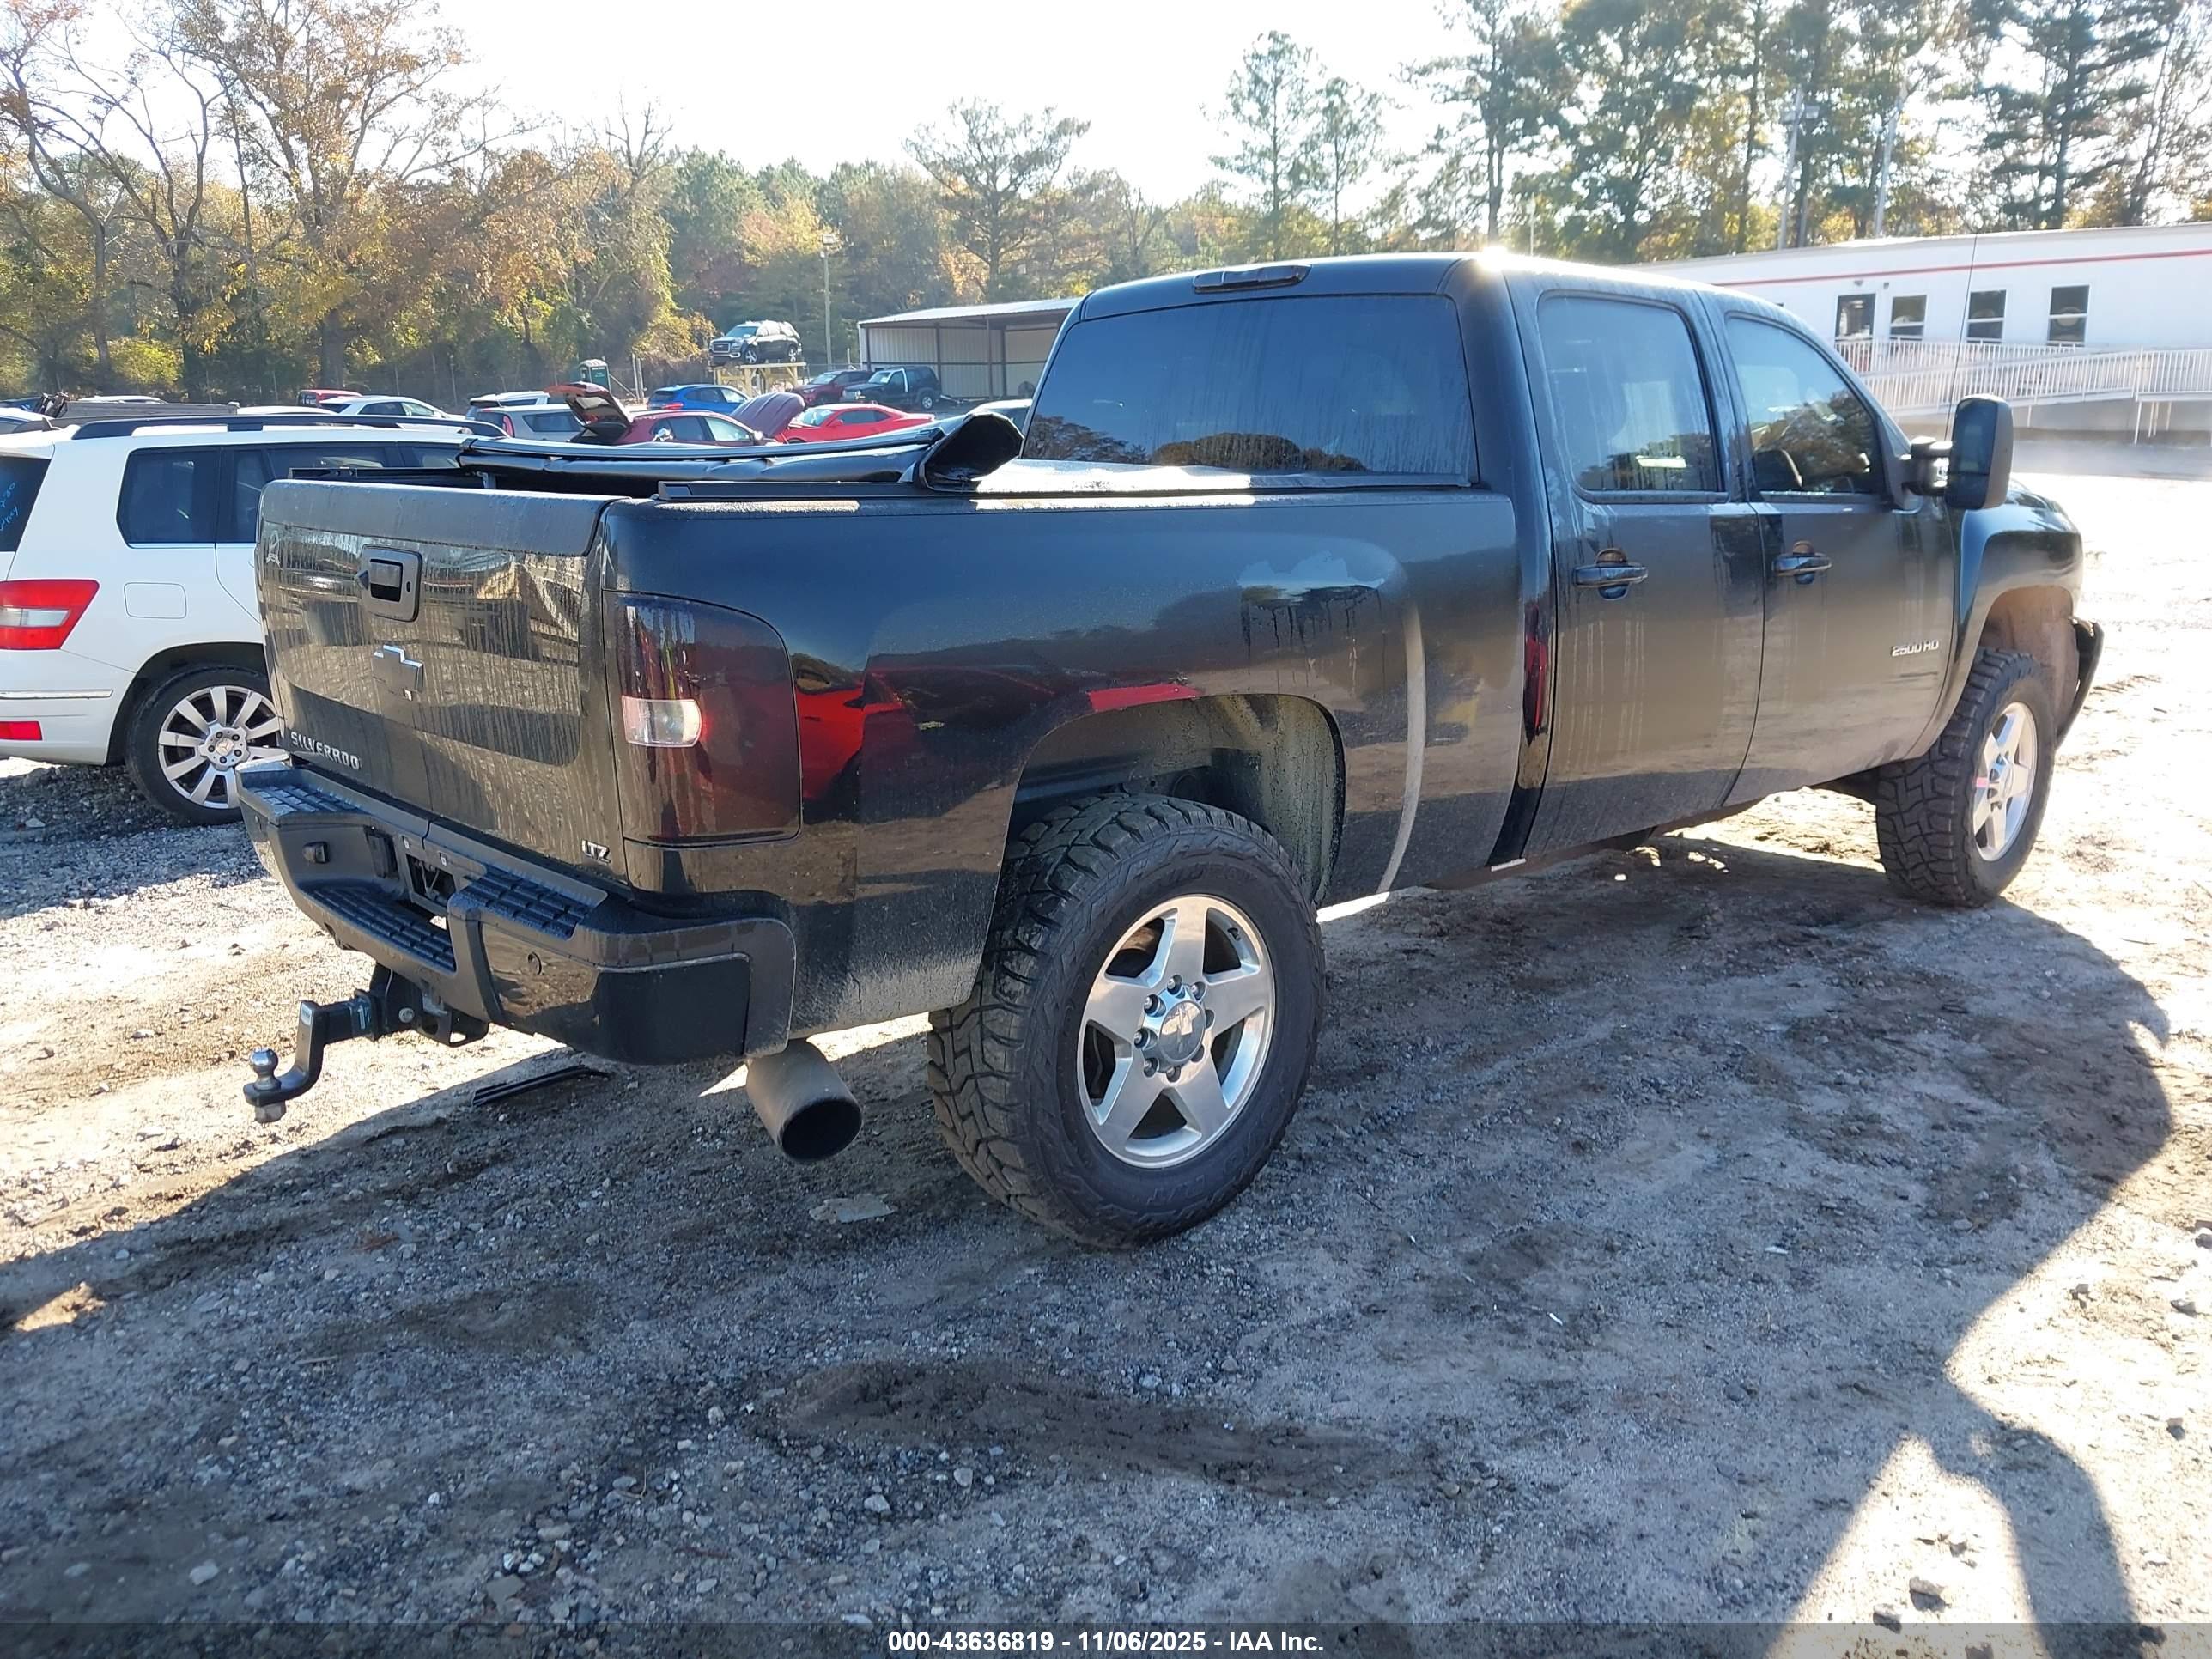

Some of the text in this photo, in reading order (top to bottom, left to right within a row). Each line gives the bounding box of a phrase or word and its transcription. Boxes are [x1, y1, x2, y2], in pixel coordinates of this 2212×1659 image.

[1891, 640, 1940, 657] 2500 HD
[290, 731, 361, 770] SILVERADO
[581, 840, 611, 864] LTZ
